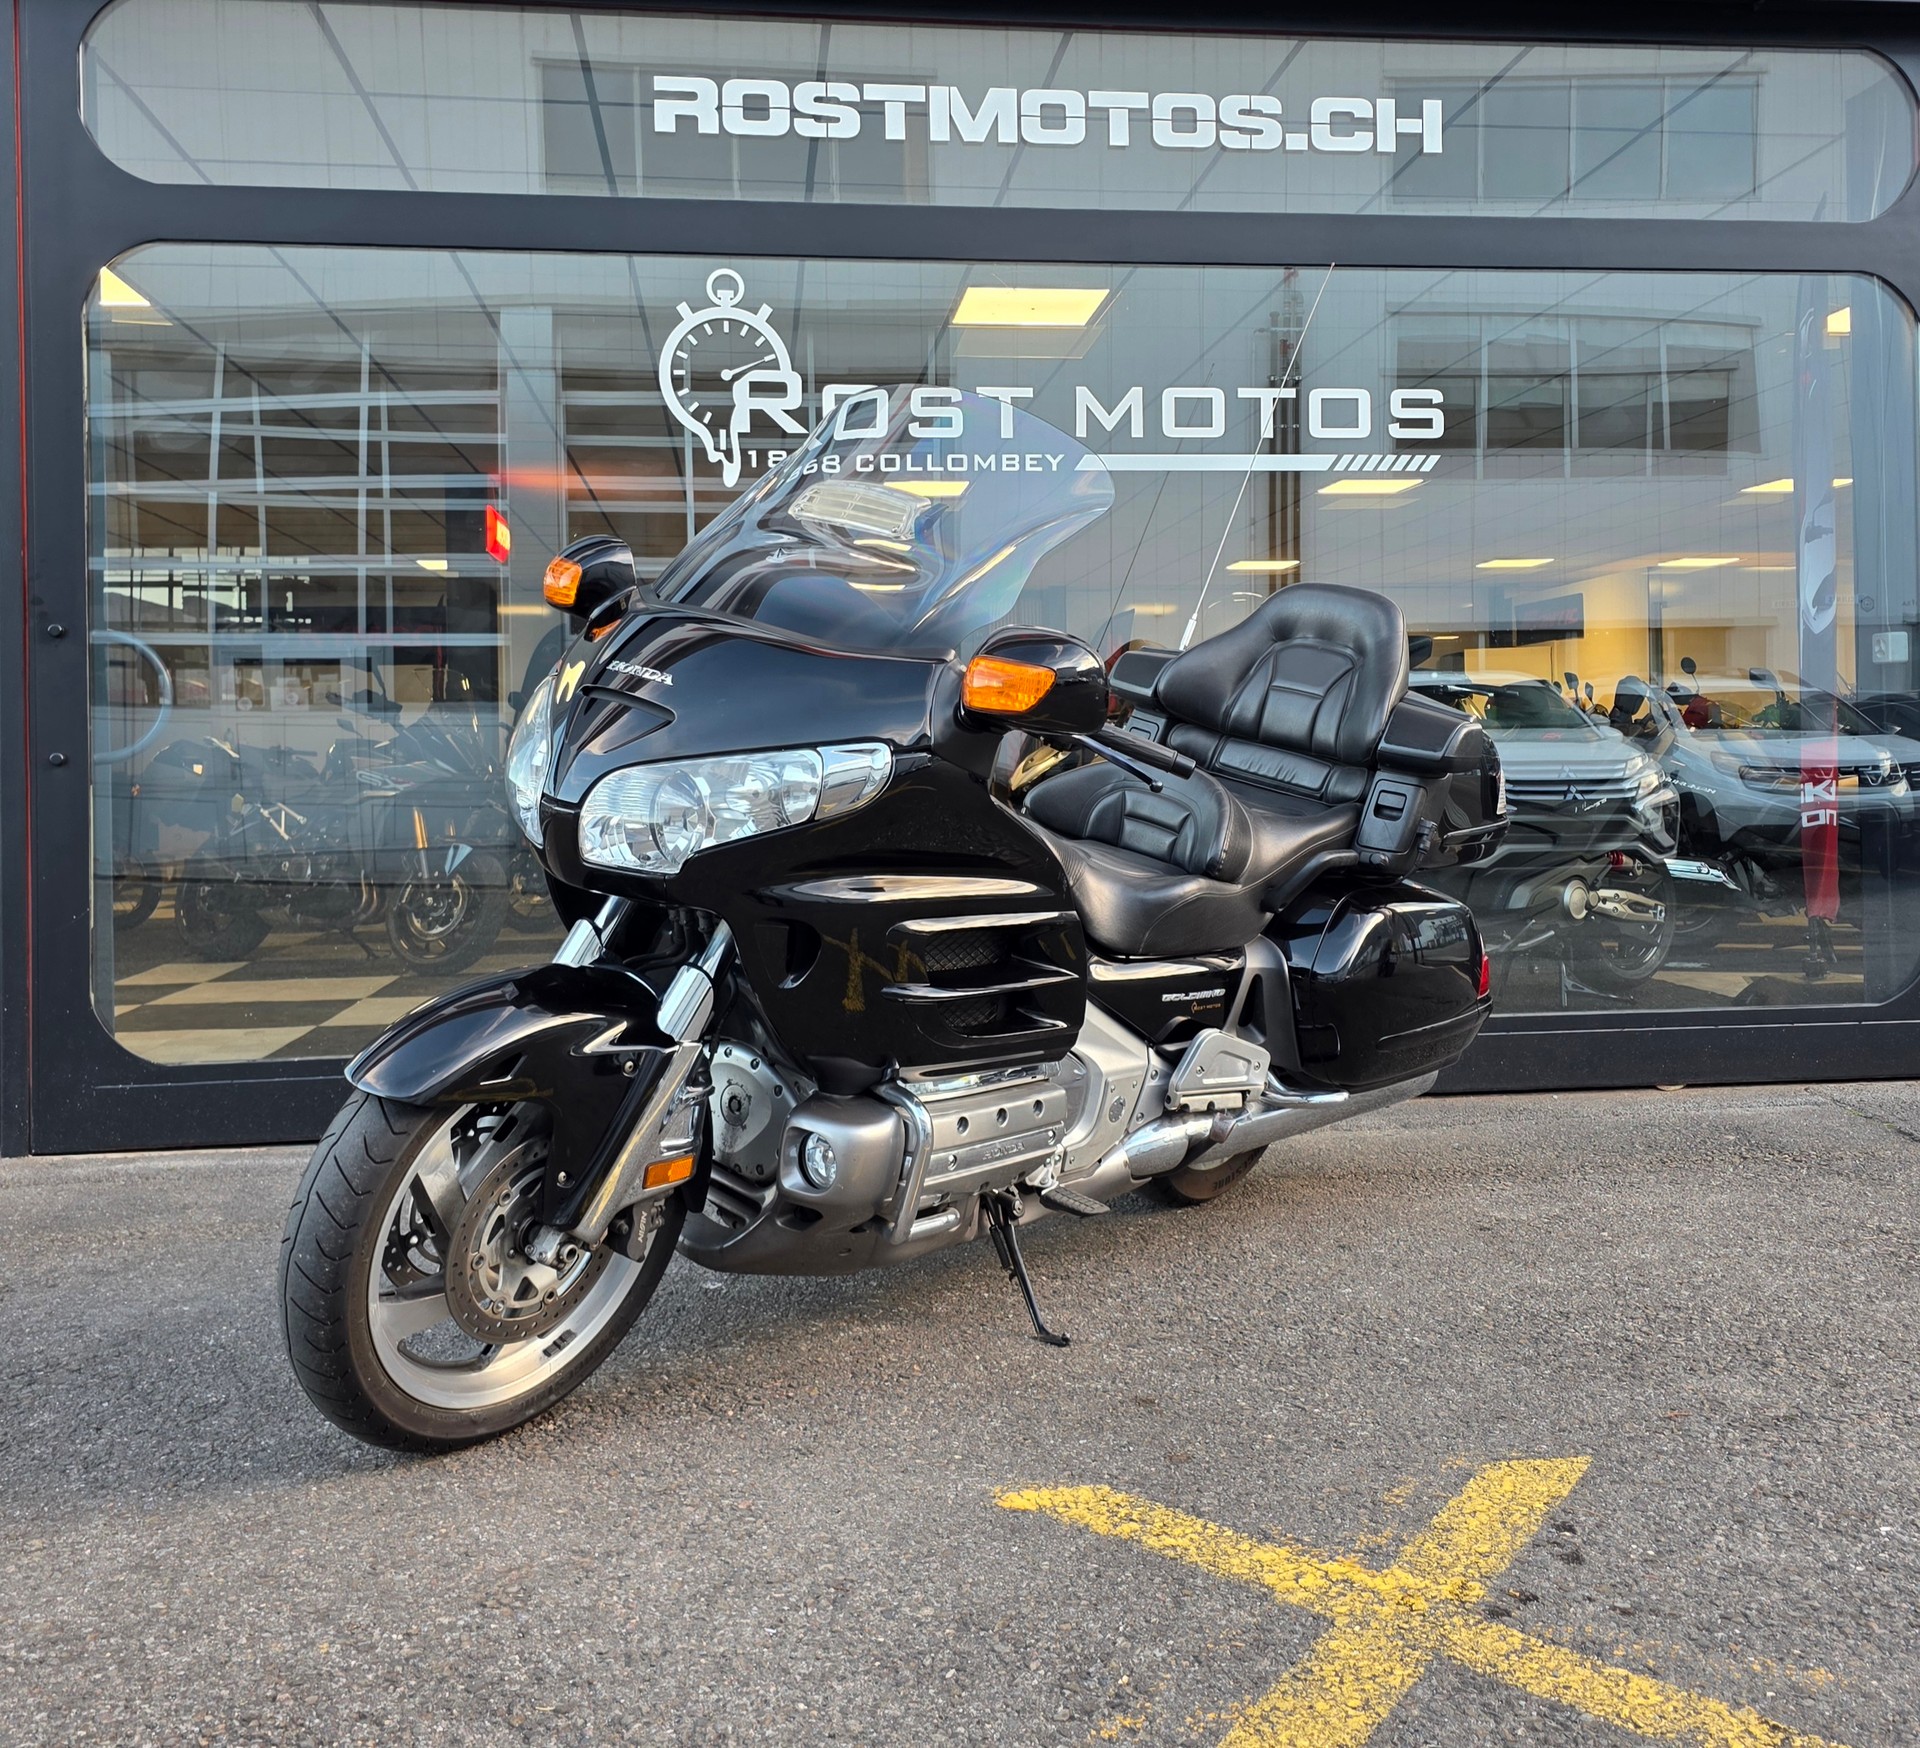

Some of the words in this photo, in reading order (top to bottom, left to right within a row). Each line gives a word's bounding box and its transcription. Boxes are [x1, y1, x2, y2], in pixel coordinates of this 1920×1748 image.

[653, 74, 1443, 154] ROSTMOTOS.CH
[733, 369, 1034, 440] ROST
[1075, 386, 1445, 439] MOTOS
[856, 452, 1065, 473] COLLOMBEY
[606, 660, 674, 686] HONDA
